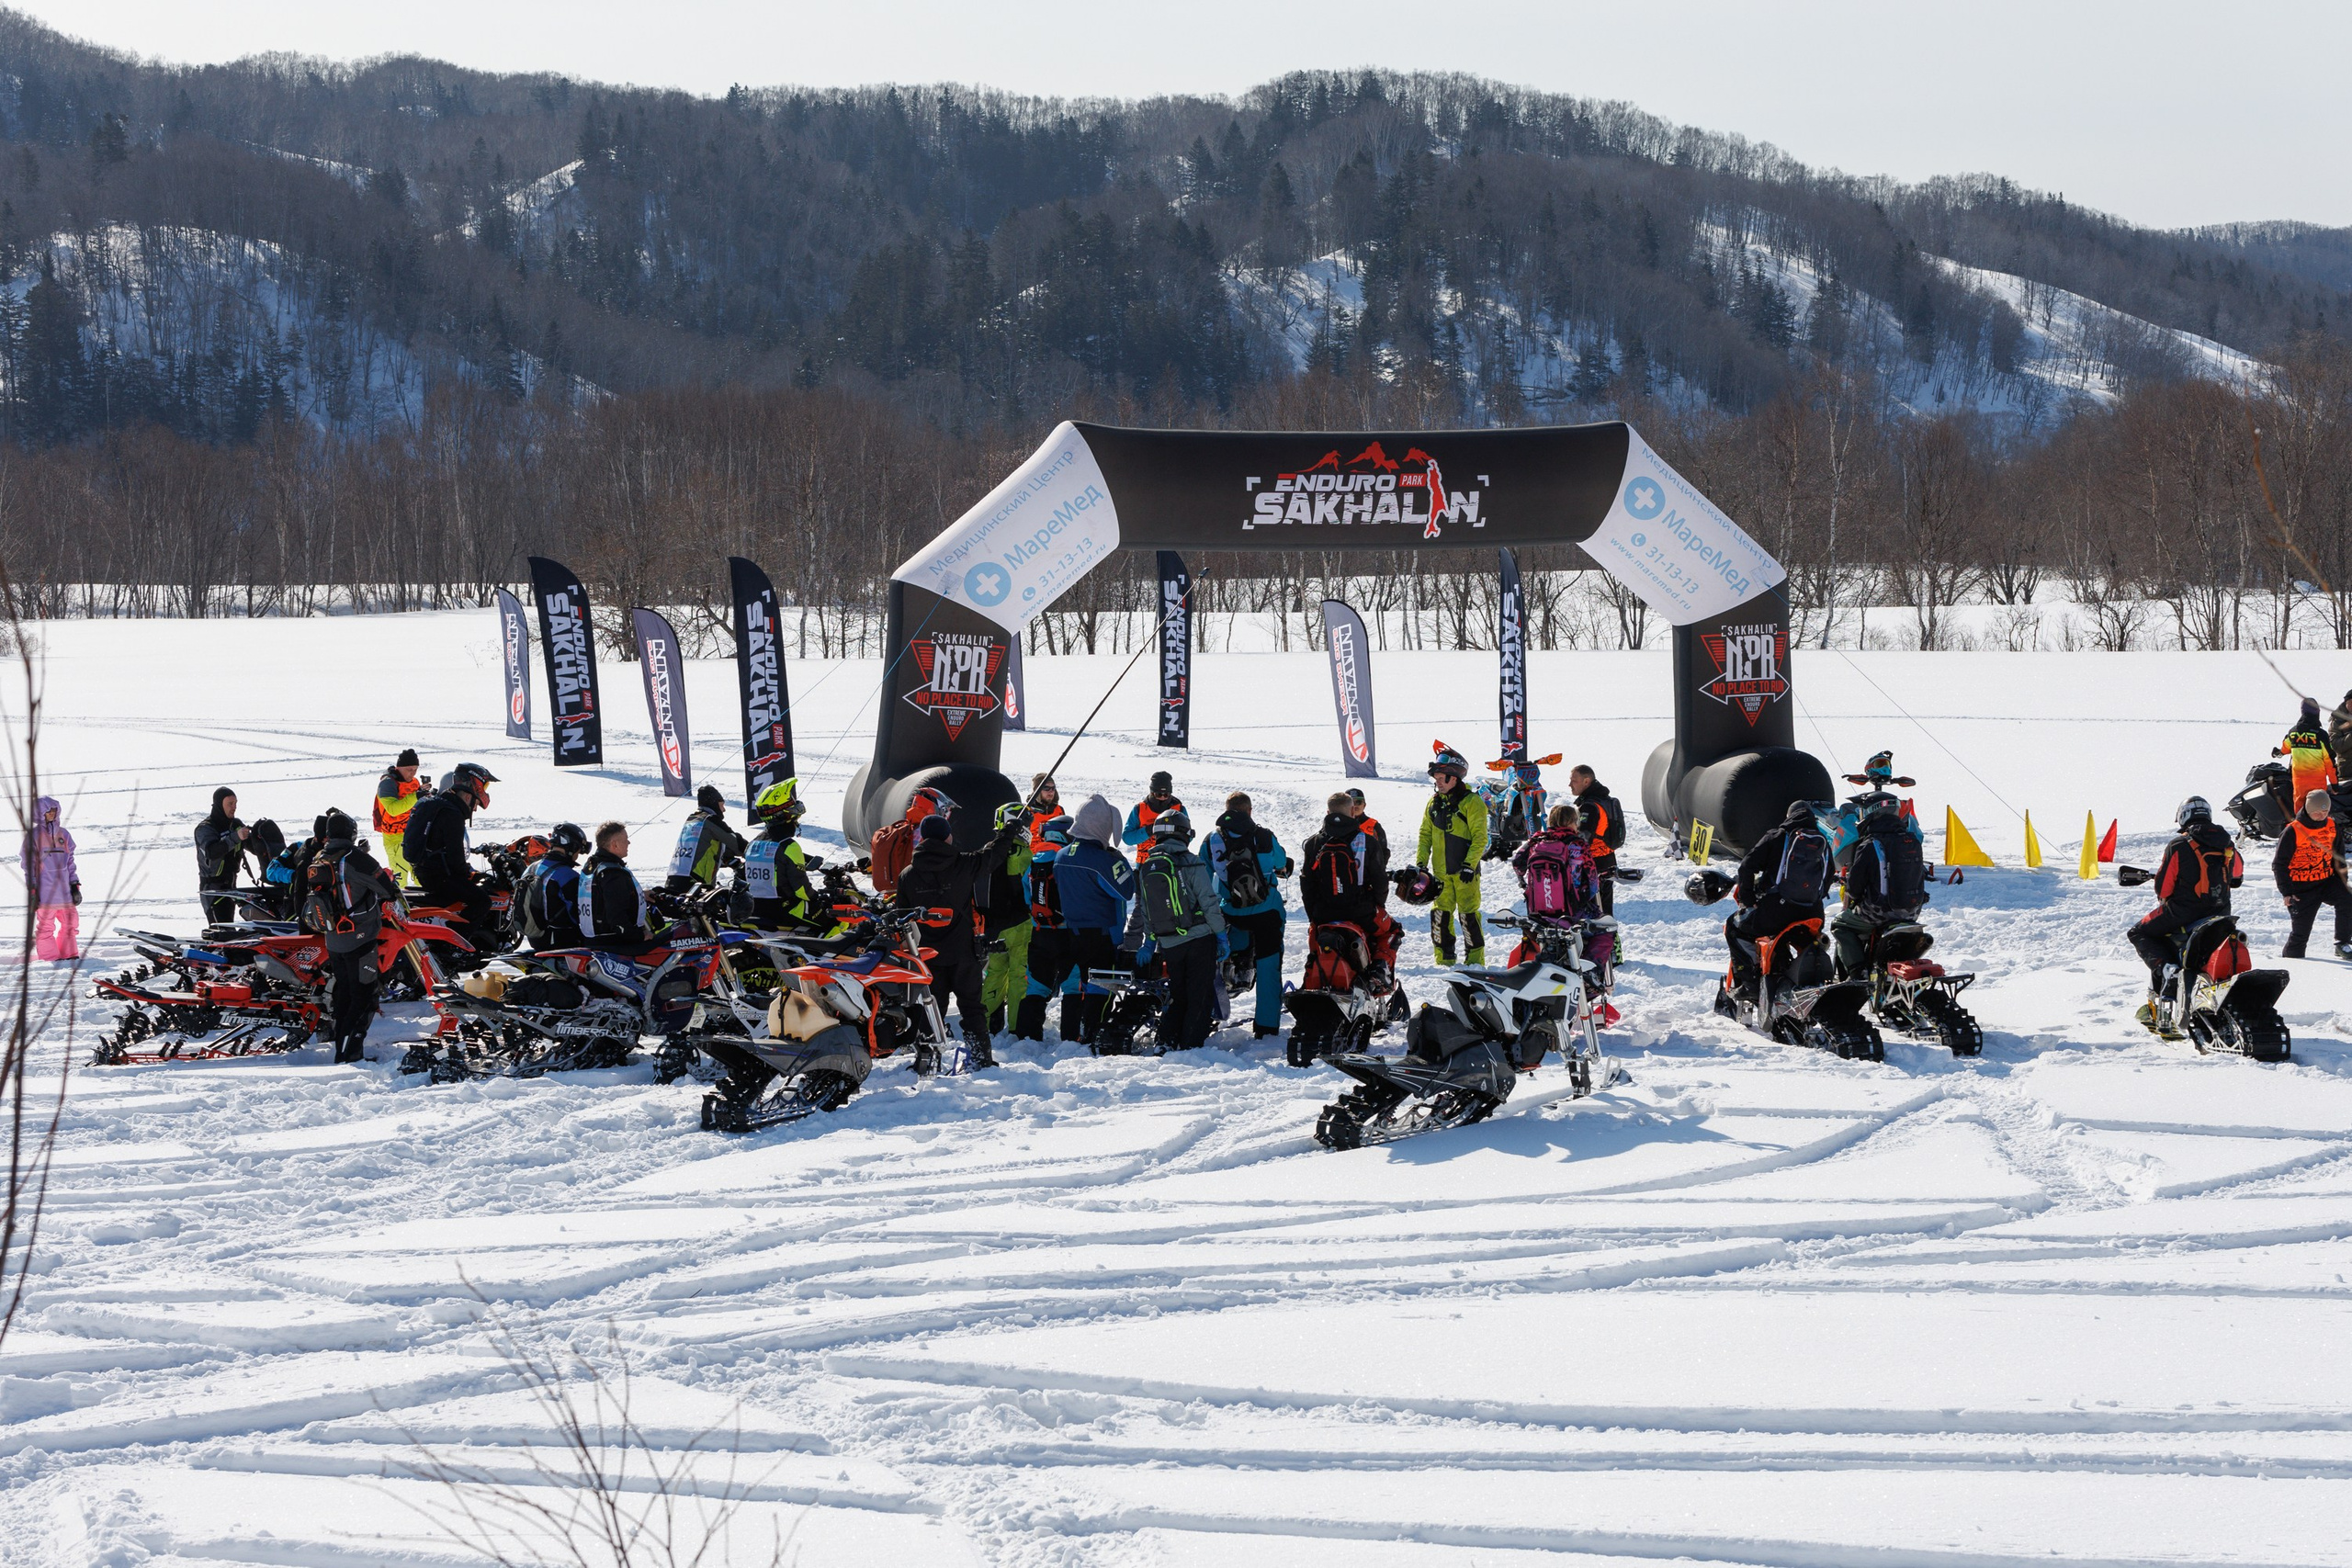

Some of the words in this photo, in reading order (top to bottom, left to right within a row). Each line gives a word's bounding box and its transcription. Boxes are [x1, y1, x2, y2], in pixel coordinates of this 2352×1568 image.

[1275, 473, 1396, 491] ENDURO
[1401, 475, 1424, 486] PARK
[929, 490, 1031, 576] Медицинский
[1027, 449, 1074, 492] Центр
[1003, 484, 1104, 570] МареМед
[1641, 446, 1731, 533] Медицинский
[1732, 529, 1772, 570] Центр
[1038, 536, 1093, 588] 31-13-13
[1610, 537, 1691, 612] www.maremed.ru
[1645, 546, 1700, 595] 31-13-13
[1661, 509, 1750, 597] МареМед
[1020, 544, 1106, 620] www.maremed.ru
[570, 605, 592, 689] ENDURO
[938, 633, 989, 646] SAKHALIN
[1727, 625, 1774, 636] SAKHALIN
[763, 616, 781, 721] ENDURO
[931, 643, 989, 694] NPR
[1725, 634, 1775, 682] NPR
[916, 691, 930, 705] NO
[931, 693, 962, 706] PLACE
[965, 694, 977, 707] TO
[978, 695, 993, 708] RUN
[1712, 682, 1725, 695] NO
[1727, 682, 1757, 694] PLACE
[1758, 681, 1769, 693] TO
[1770, 680, 1784, 693] RUN
[2290, 731, 2317, 744] FXR
[1693, 826, 1707, 854] 30
[747, 867, 770, 881] 2618
[1544, 877, 1553, 909] FXR
